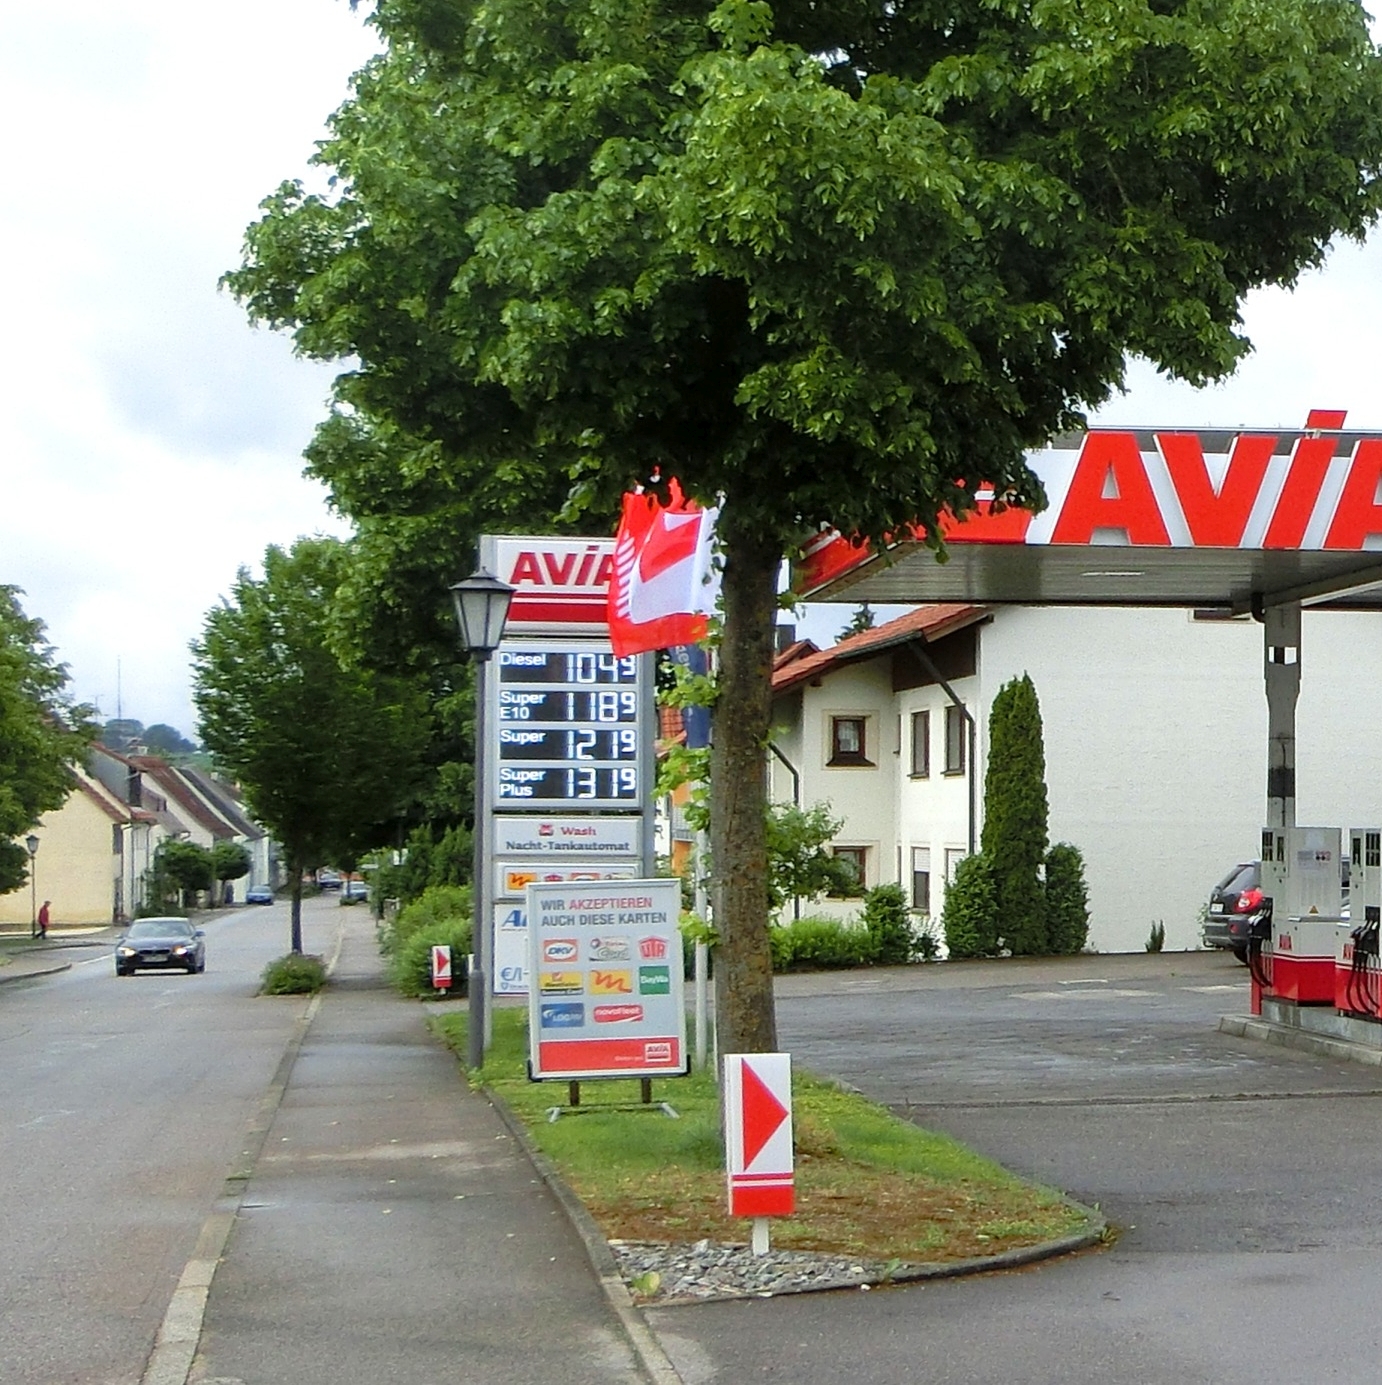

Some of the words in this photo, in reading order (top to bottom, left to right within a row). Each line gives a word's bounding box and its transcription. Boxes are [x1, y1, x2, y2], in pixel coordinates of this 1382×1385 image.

[500, 653, 546, 666] Diesel
[500, 691, 545, 706] Super
[500, 706, 530, 720] E10
[500, 730, 546, 745] Super
[500, 768, 545, 783] Super
[500, 784, 533, 797] Plus
[560, 826, 597, 836] Wash
[505, 841, 630, 852] Nacht-Tankautomat
[541, 899, 565, 911] WIR
[568, 897, 653, 910] AKZEPTIEREN
[541, 915, 575, 927] AUCH
[579, 913, 615, 925] DIESE
[618, 912, 667, 924] KARTEN
